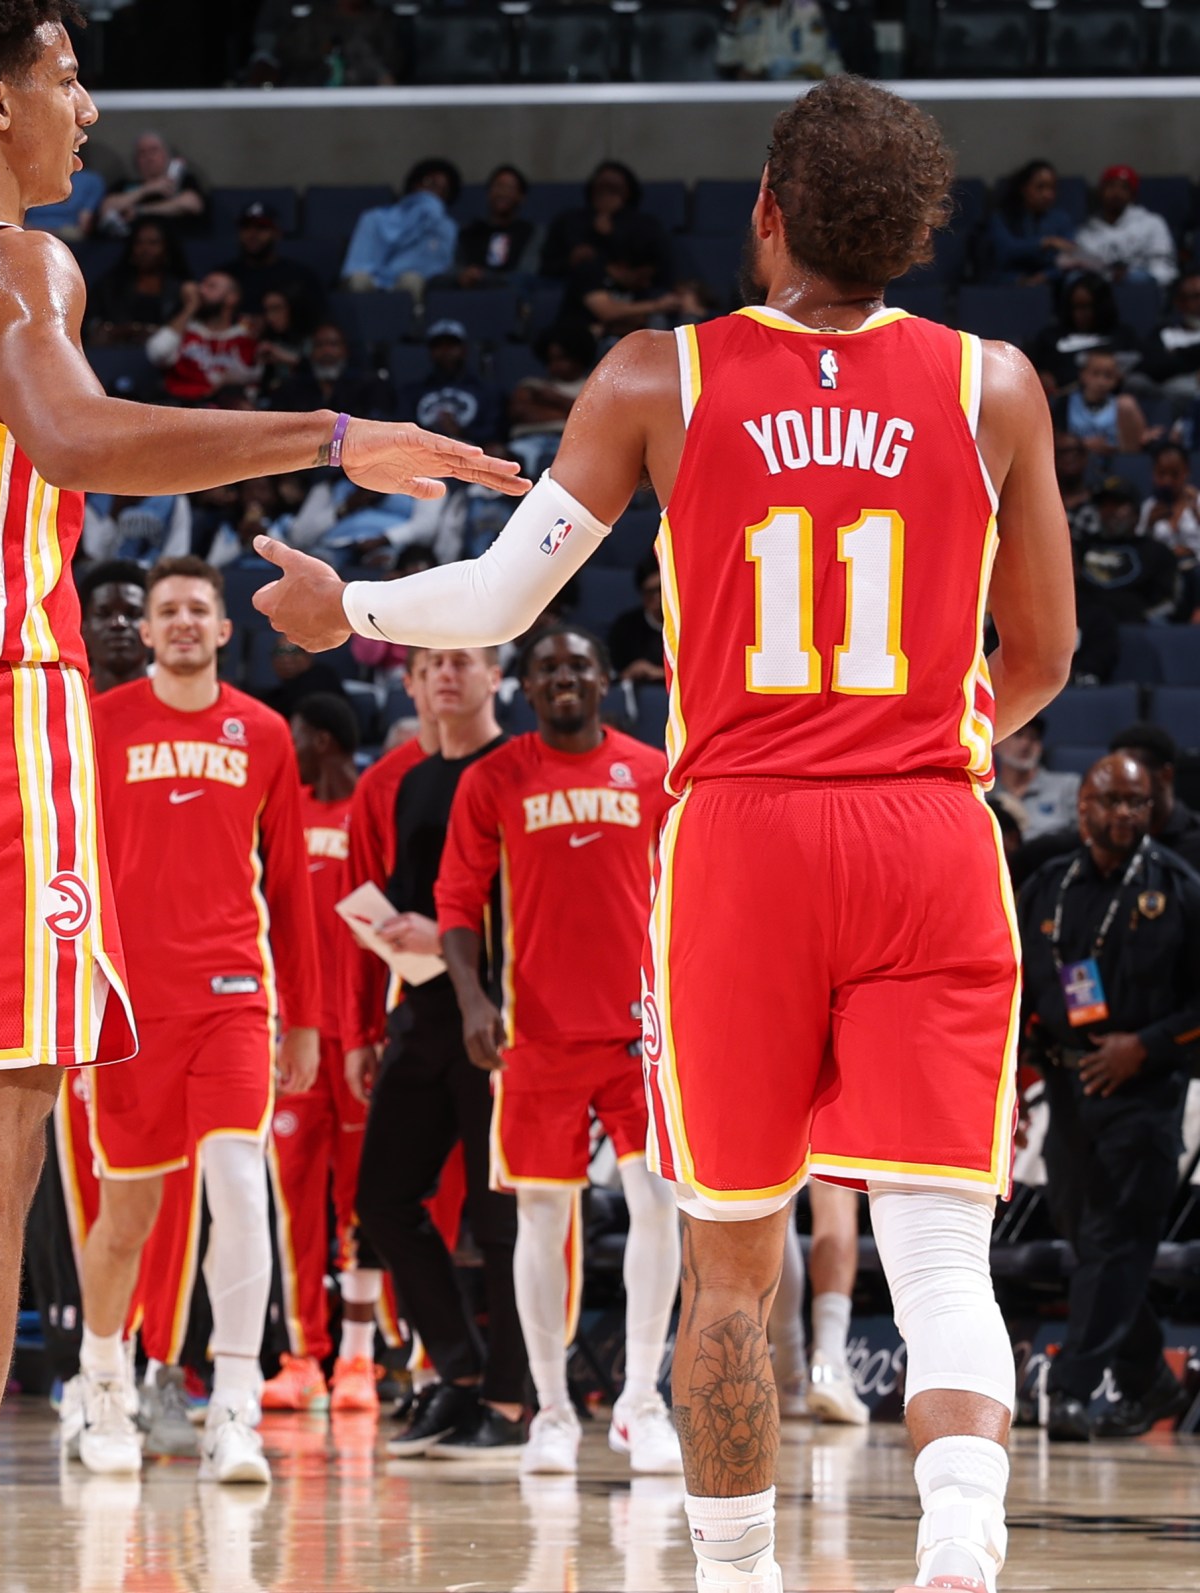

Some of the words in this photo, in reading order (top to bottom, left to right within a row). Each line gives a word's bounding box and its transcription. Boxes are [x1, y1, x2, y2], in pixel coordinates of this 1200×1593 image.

[742, 406, 915, 478] YOUNG
[744, 506, 909, 695] 11
[125, 740, 248, 788] HAWKS
[523, 787, 641, 834] HAWKS
